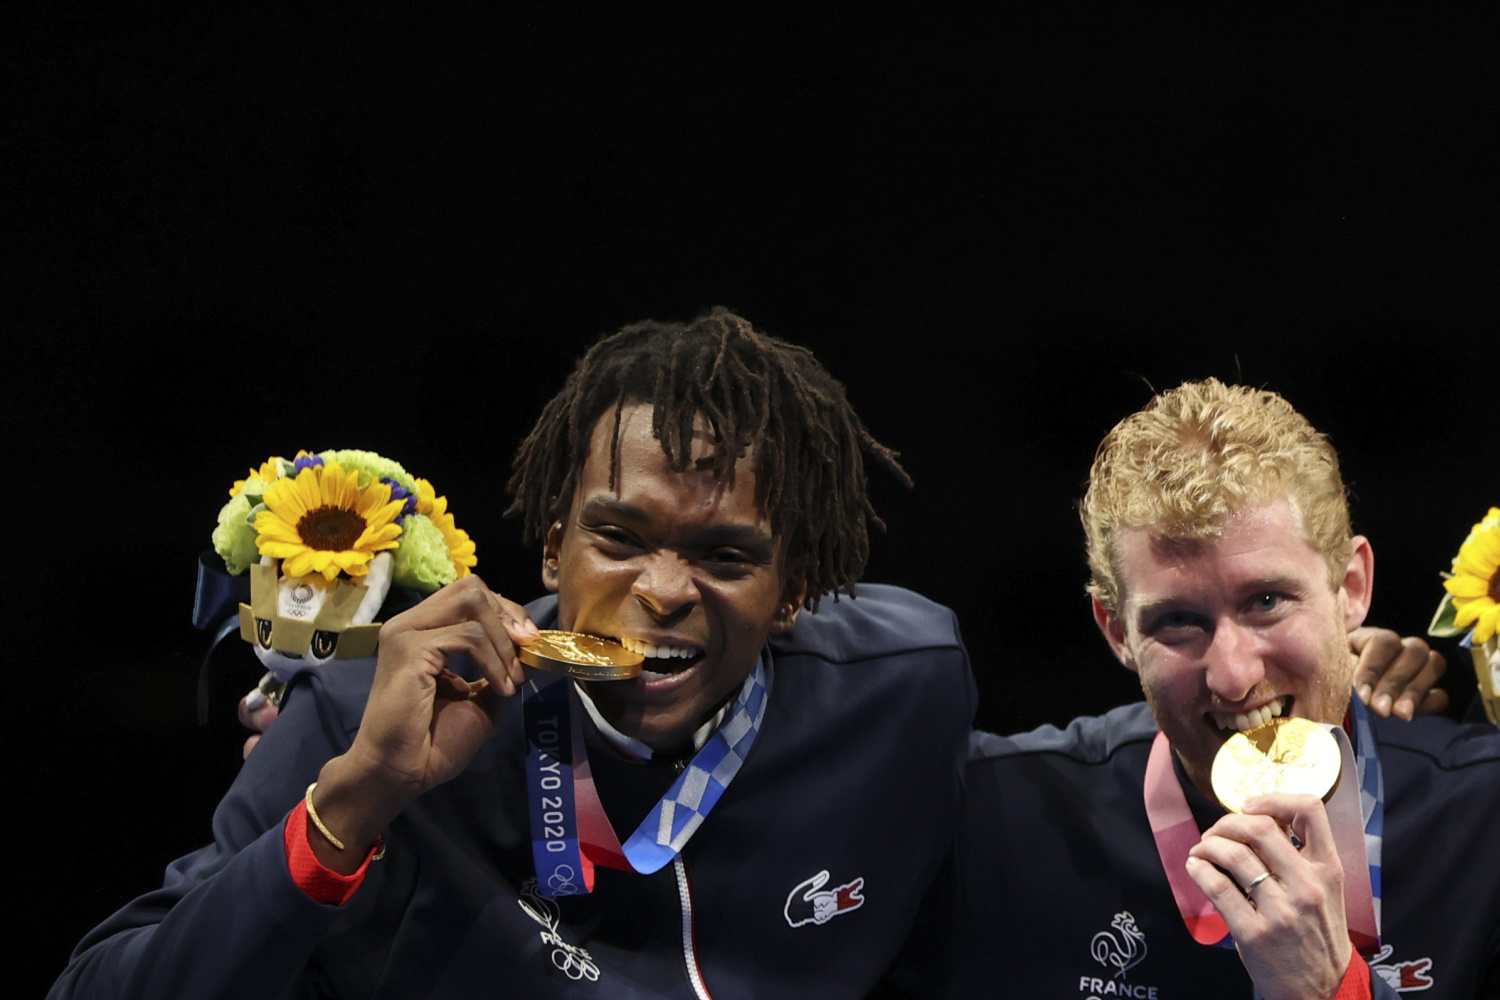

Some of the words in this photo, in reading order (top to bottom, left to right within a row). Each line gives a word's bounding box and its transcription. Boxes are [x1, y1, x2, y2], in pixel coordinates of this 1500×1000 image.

[537, 715, 562, 791] TOKYO
[541, 796, 567, 853] 2020
[1079, 975, 1159, 1000] FRANCE
